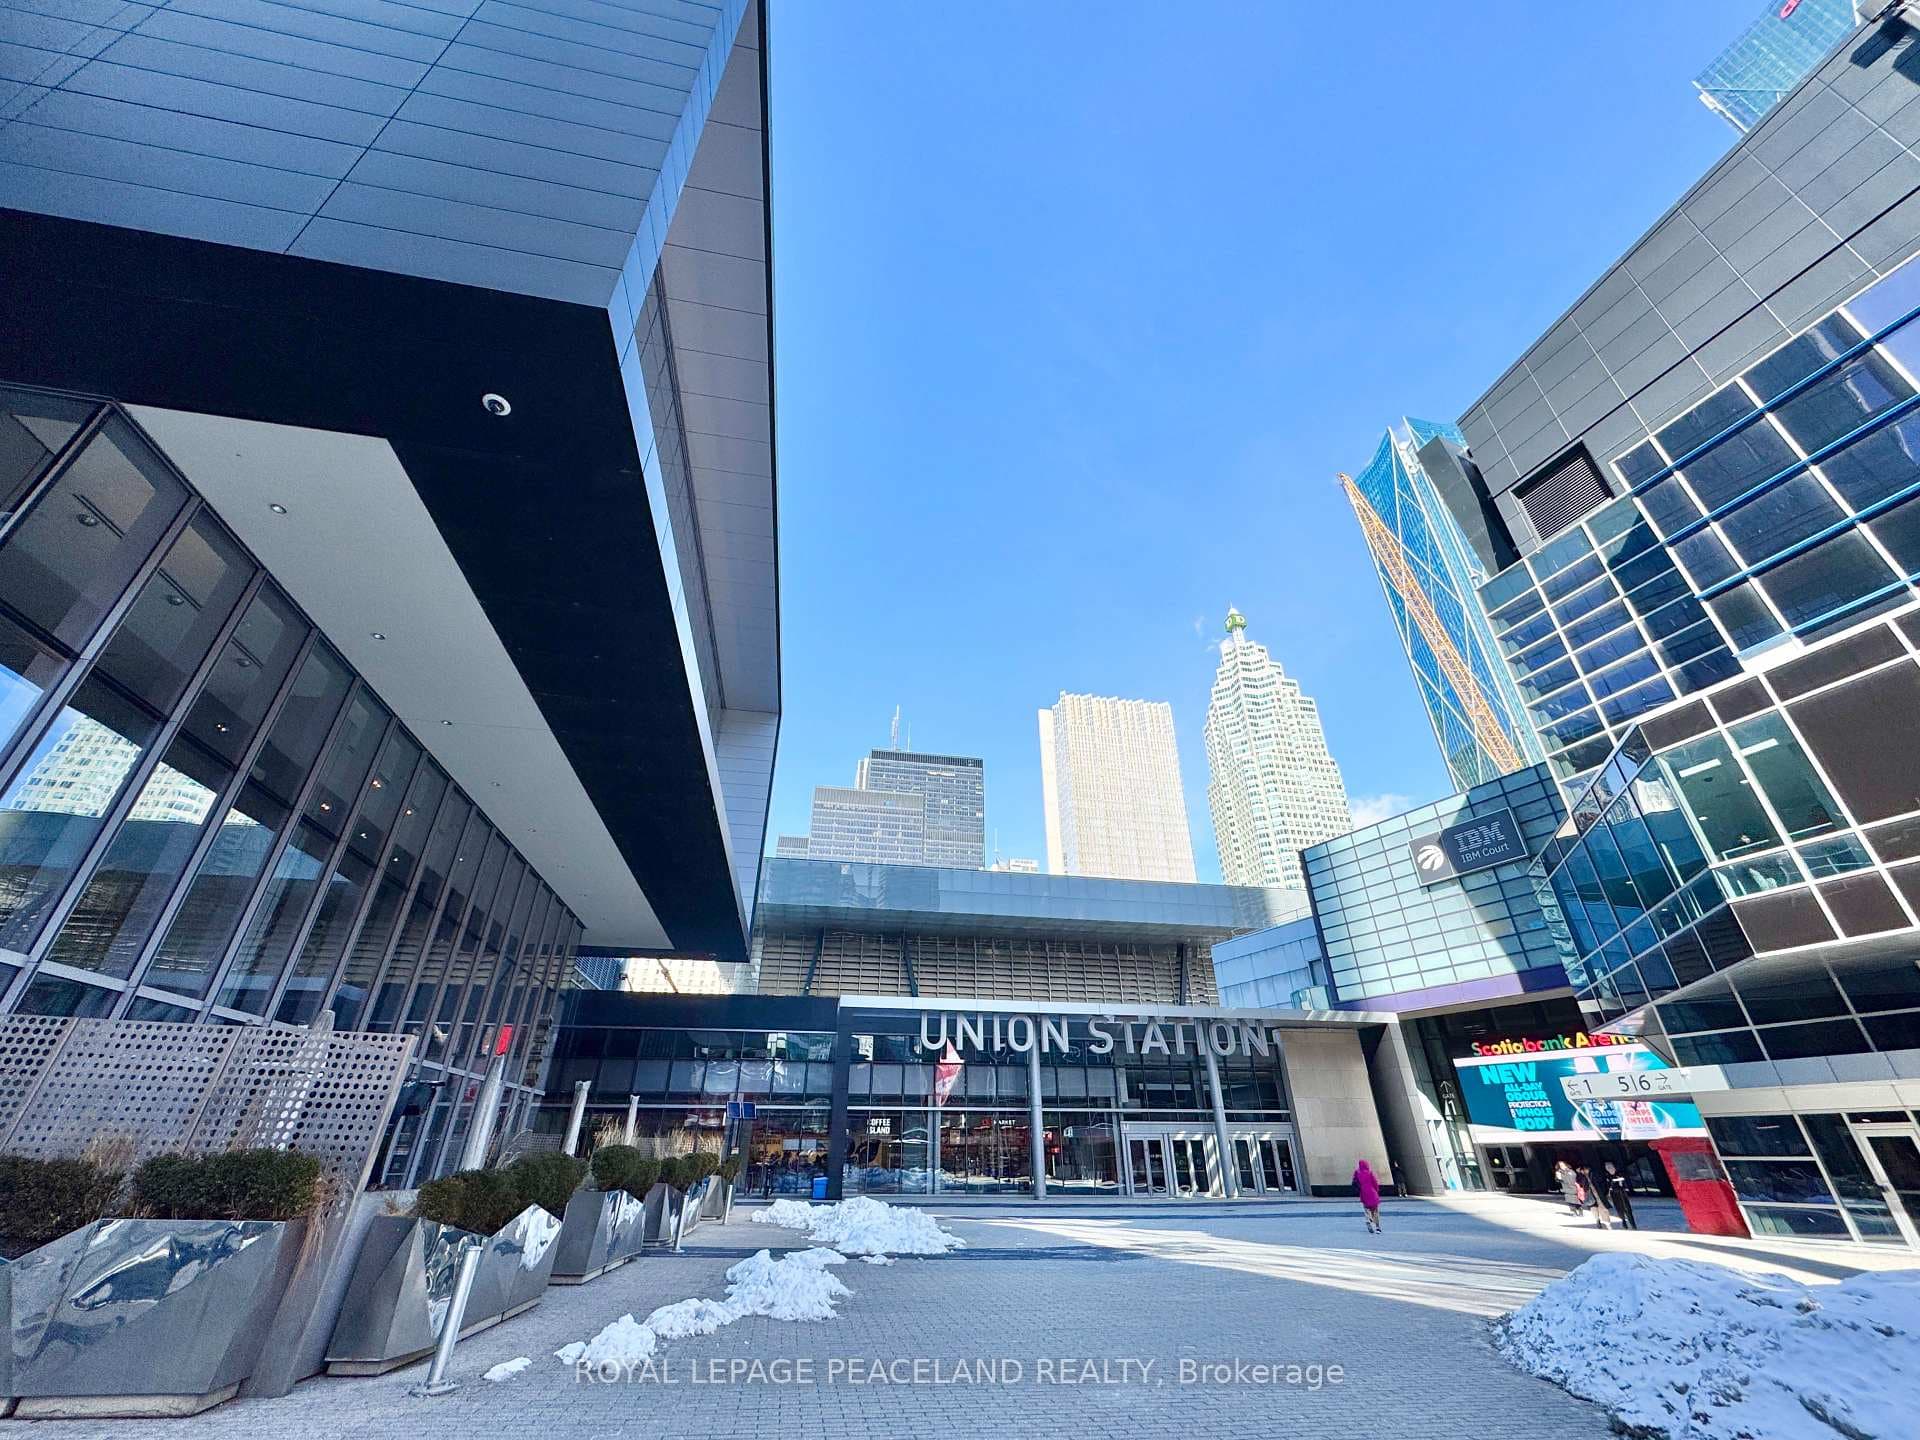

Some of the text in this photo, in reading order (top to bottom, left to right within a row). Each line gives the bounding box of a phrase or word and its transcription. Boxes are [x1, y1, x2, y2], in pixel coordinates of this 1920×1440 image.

[1454, 821, 1505, 853] IBM
[1461, 842, 1510, 863] IBM Court
[920, 1011, 1270, 1057] UNION STATION
[1471, 1034, 1573, 1057] Scotiabank
[1478, 1062, 1536, 1085] NEW
[1504, 1082, 1543, 1092] ALL-DAY
[1582, 1079, 1593, 1094] 1
[1506, 1091, 1548, 1101] ODOUR
[1508, 1100, 1552, 1109] PROTECTION
[1515, 1108, 1554, 1117] WHOLE
[866, 1118, 891, 1126] COFFEE
[1514, 1117, 1555, 1130] BODY
[866, 1126, 891, 1134] ISLAND
